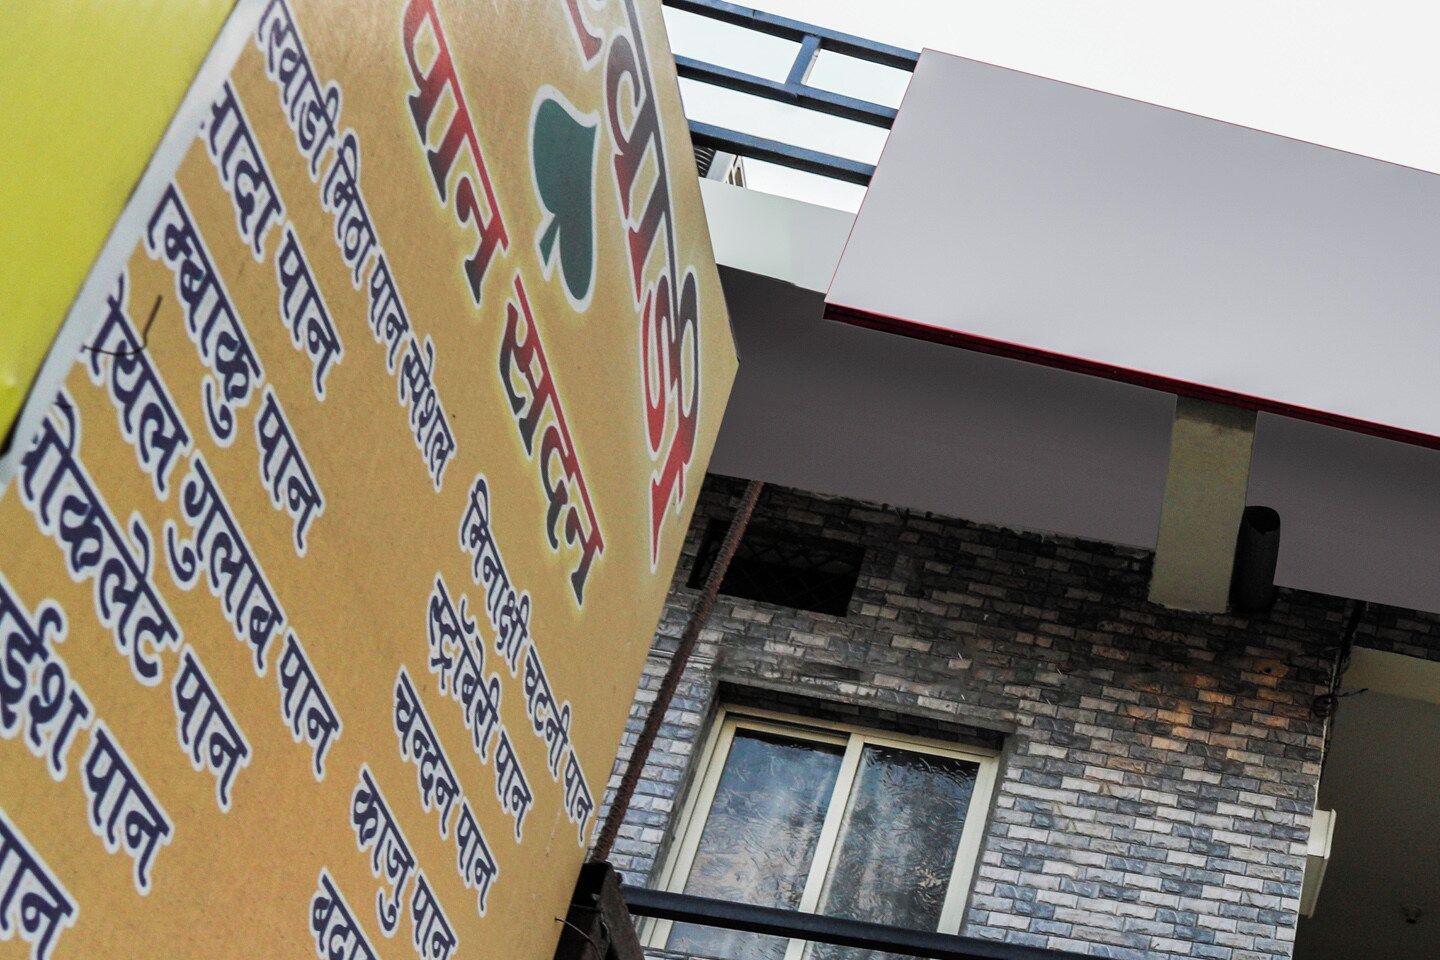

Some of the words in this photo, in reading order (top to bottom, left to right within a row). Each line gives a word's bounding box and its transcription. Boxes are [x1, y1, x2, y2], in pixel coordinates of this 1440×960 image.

[278, 230, 341, 394] पान
[324, 134, 376, 284] मिठा
[369, 254, 409, 370] पान
[400, 339, 455, 488] स्पेशल
[403, 0, 508, 303] पान
[500, 275, 604, 604] सदन
[563, 0, 701, 567] वाडी
[258, 392, 322, 550] पान
[167, 458, 284, 670] गुलाब
[279, 634, 339, 775] पान
[461, 478, 530, 666] मिनाक्षी
[526, 647, 570, 775] चटनी
[565, 751, 593, 840] पान
[86, 728, 170, 887] पान
[175, 652, 249, 806] पान
[395, 671, 460, 834] चन्दन
[456, 802, 497, 910] पान
[496, 731, 532, 837] पान
[353, 770, 415, 932] काजु
